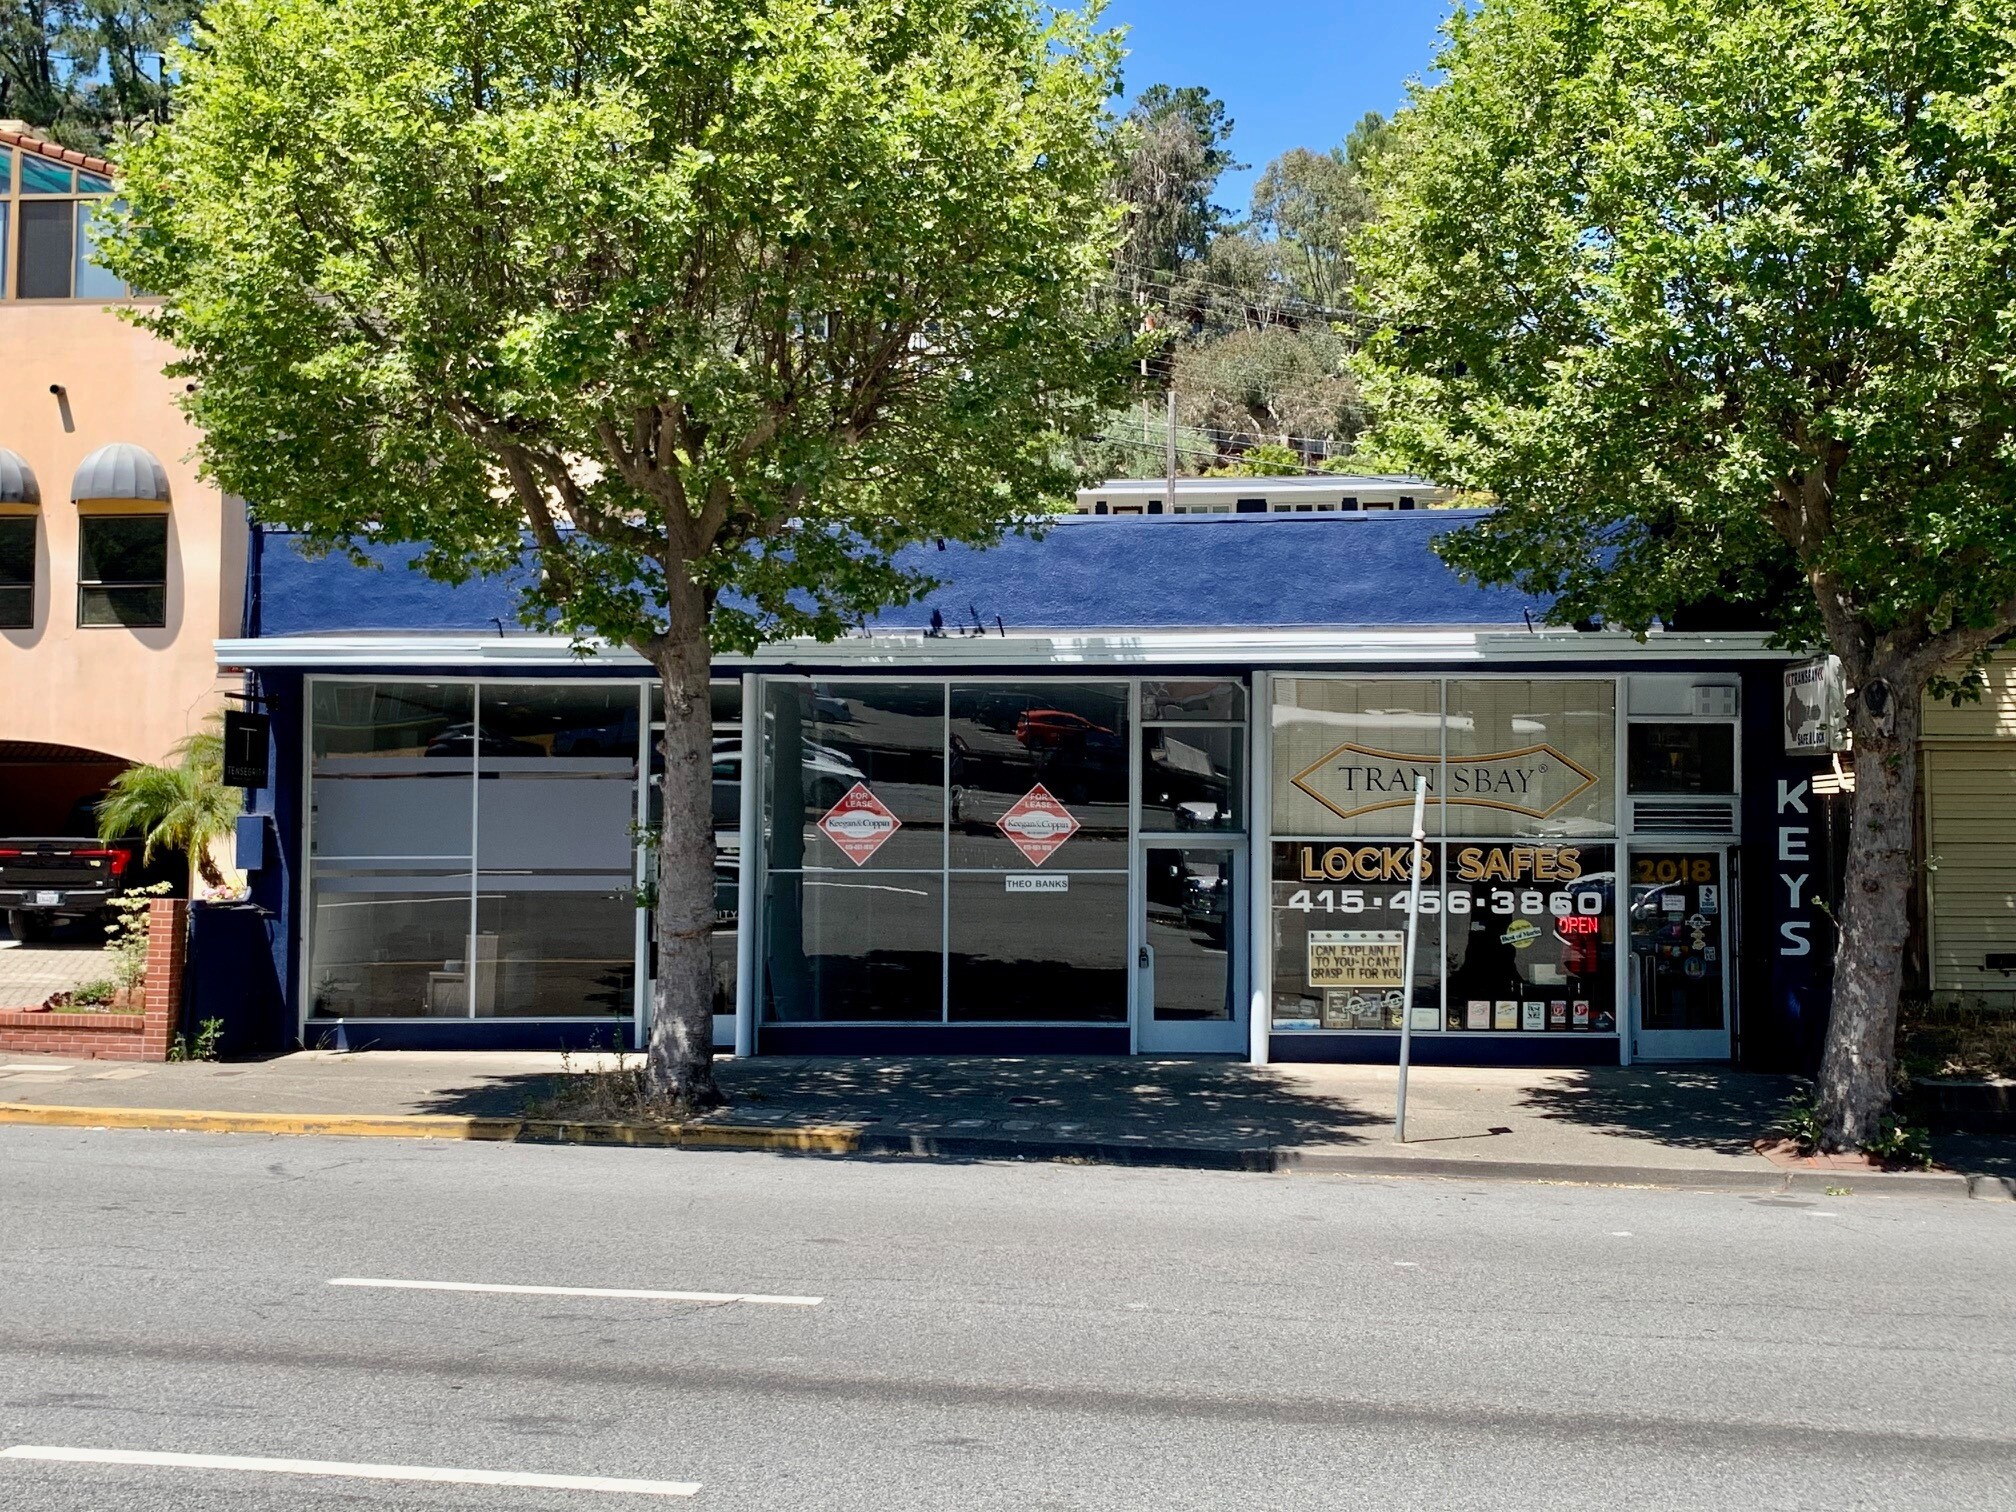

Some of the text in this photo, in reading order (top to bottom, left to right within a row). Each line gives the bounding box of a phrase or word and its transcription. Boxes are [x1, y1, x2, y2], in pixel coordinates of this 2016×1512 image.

[845, 800, 873, 808] LEASE
[1024, 801, 1052, 809] LEASE
[1300, 847, 1582, 882] LOCKS SAFES
[1777, 779, 1811, 956] KEYS
[1637, 859, 1712, 882] 2018
[1007, 880, 1068, 888] THEO BANKS
[1559, 916, 1598, 934] OPEN
[1316, 945, 1336, 956] CAN
[1341, 945, 1383, 956] EXPLAIN
[1388, 945, 1397, 956] IT
[1316, 957, 1330, 967] TO
[1311, 968, 1402, 979] GRASP IT FOR YOU
